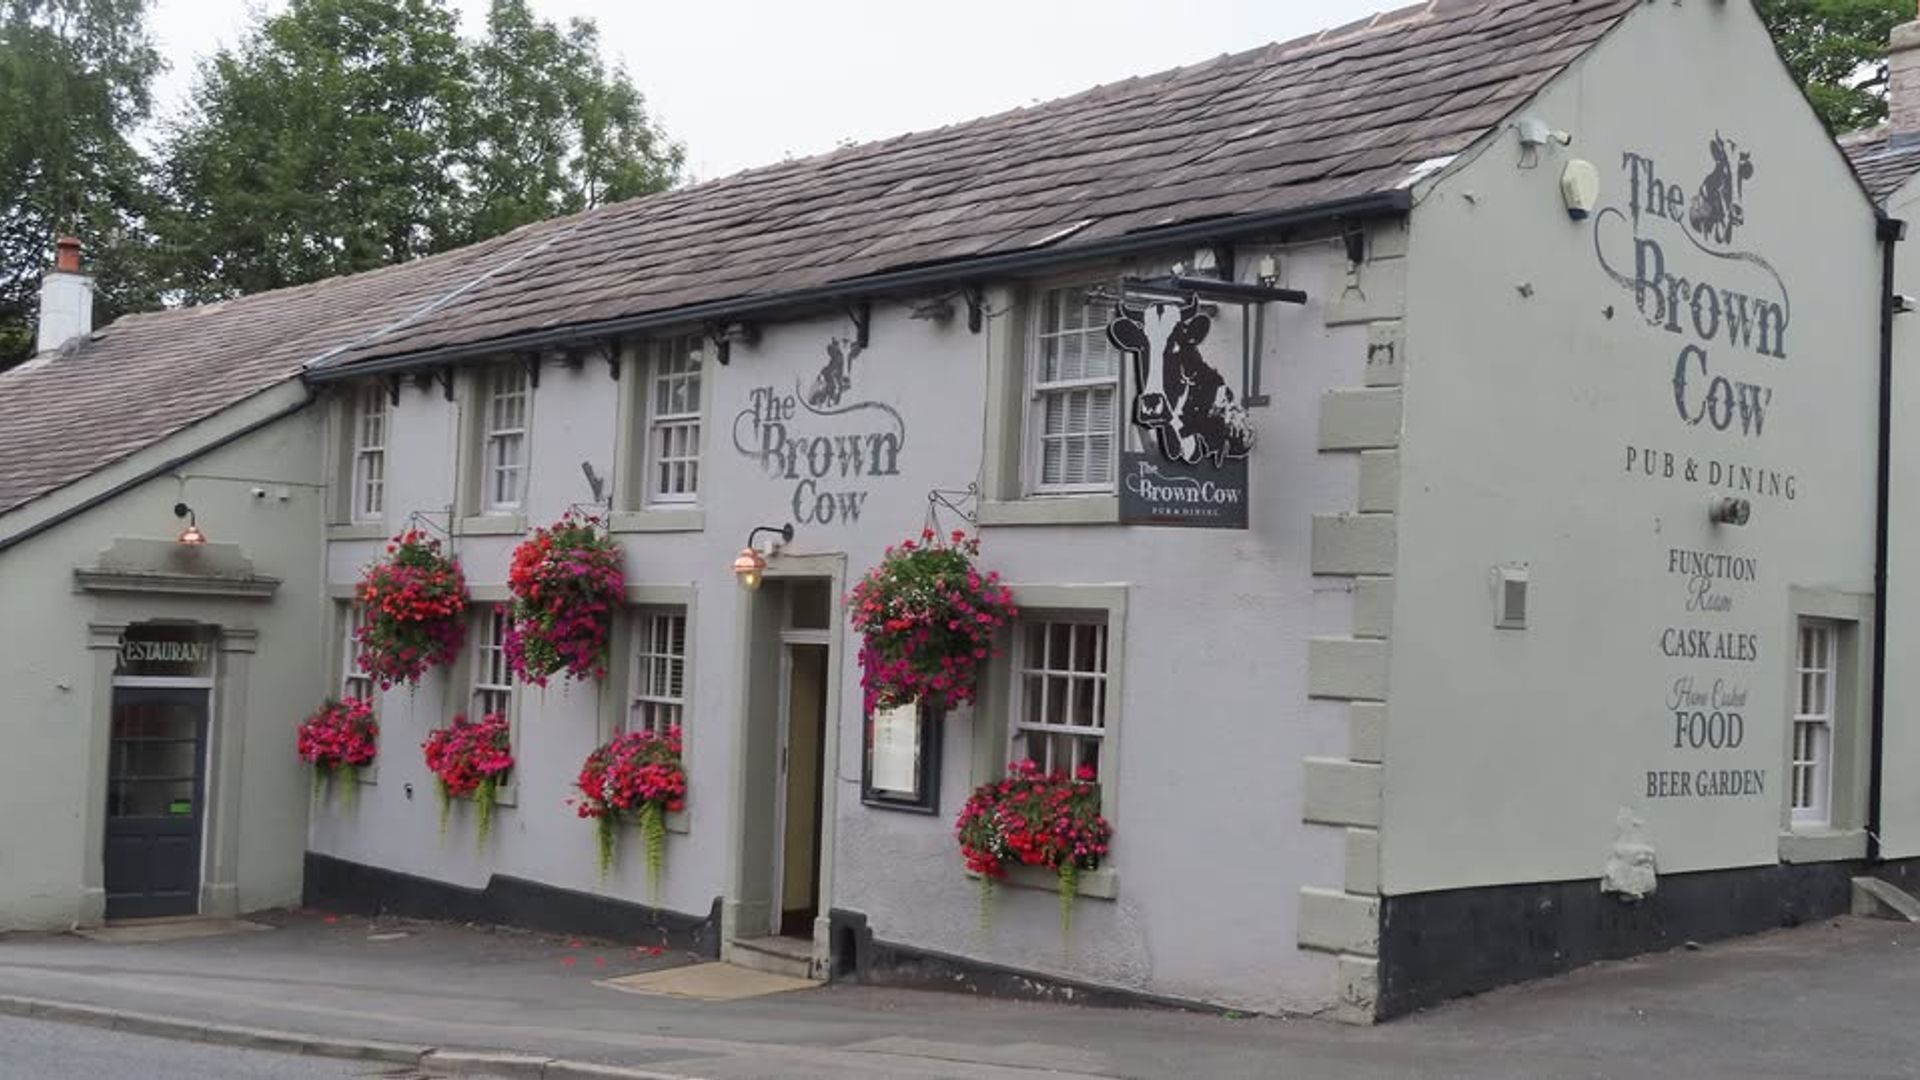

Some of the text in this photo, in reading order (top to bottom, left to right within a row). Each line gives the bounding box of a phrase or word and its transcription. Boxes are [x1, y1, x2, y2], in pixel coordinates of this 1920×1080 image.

[1622, 152, 1684, 226] The
[1633, 236, 1787, 359] Brown
[750, 387, 796, 430] The
[1672, 344, 1772, 437] Cow
[761, 423, 900, 479] Brown
[1138, 461, 1158, 475] The
[1140, 479, 1241, 503] Brown Cow
[1626, 447, 1796, 501] PUB & DINING
[792, 479, 868, 525] Cow
[1668, 549, 1757, 581] FUNCTION
[1686, 575, 1733, 611] Room
[1661, 628, 1757, 661] CASK ALES
[1674, 711, 1744, 749] FOOD
[1646, 769, 1766, 798] BEER GARDEN
